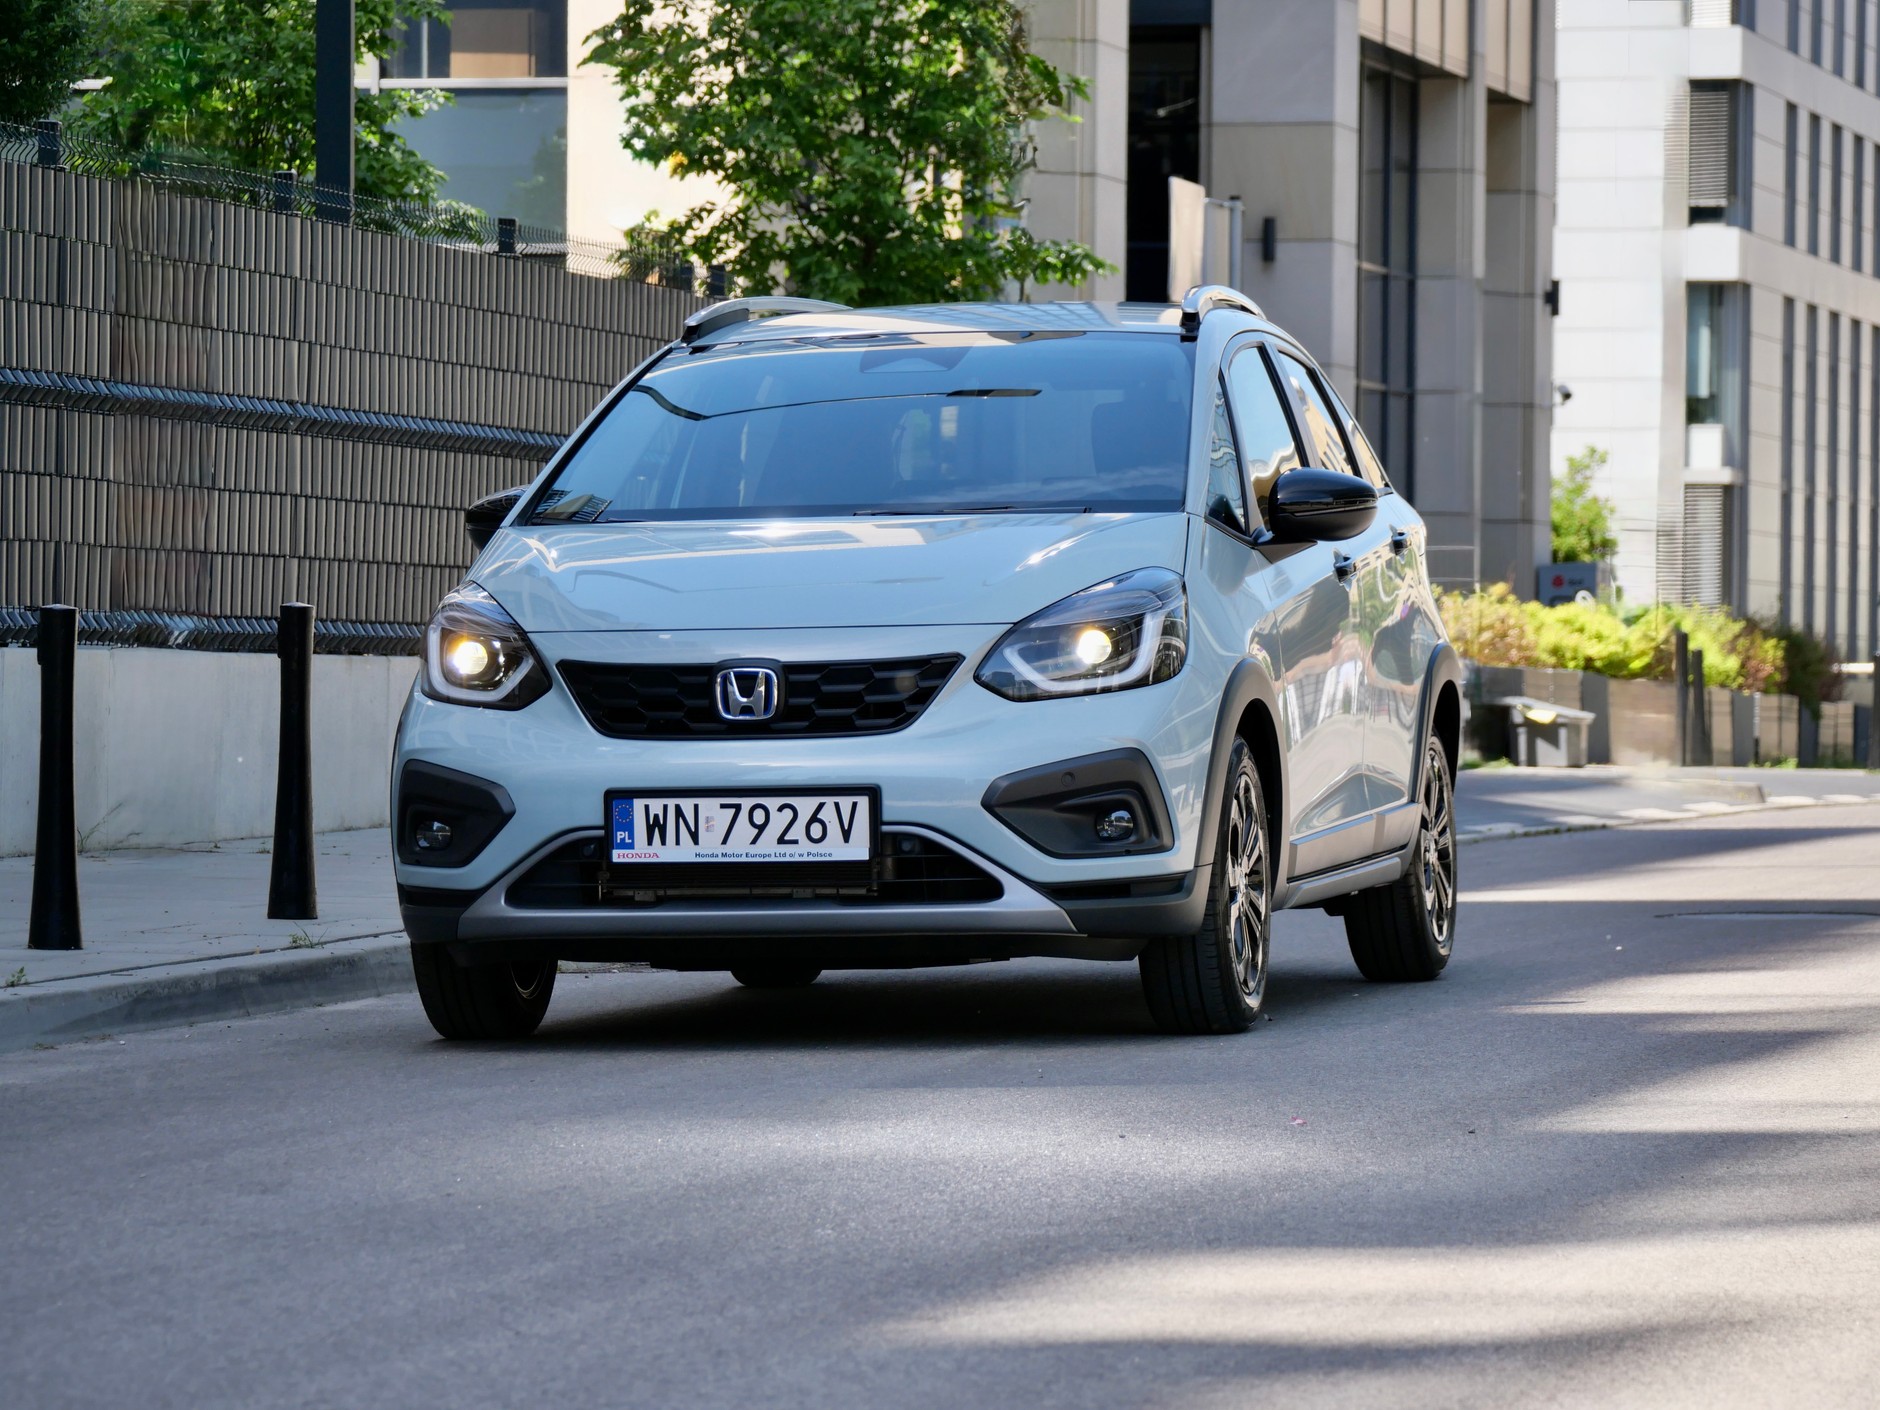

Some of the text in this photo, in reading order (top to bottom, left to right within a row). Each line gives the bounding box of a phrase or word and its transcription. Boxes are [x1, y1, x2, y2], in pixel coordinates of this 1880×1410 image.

[644, 801, 858, 846] WN 7926V
[616, 831, 632, 843] PL
[745, 852, 772, 860] Europe
